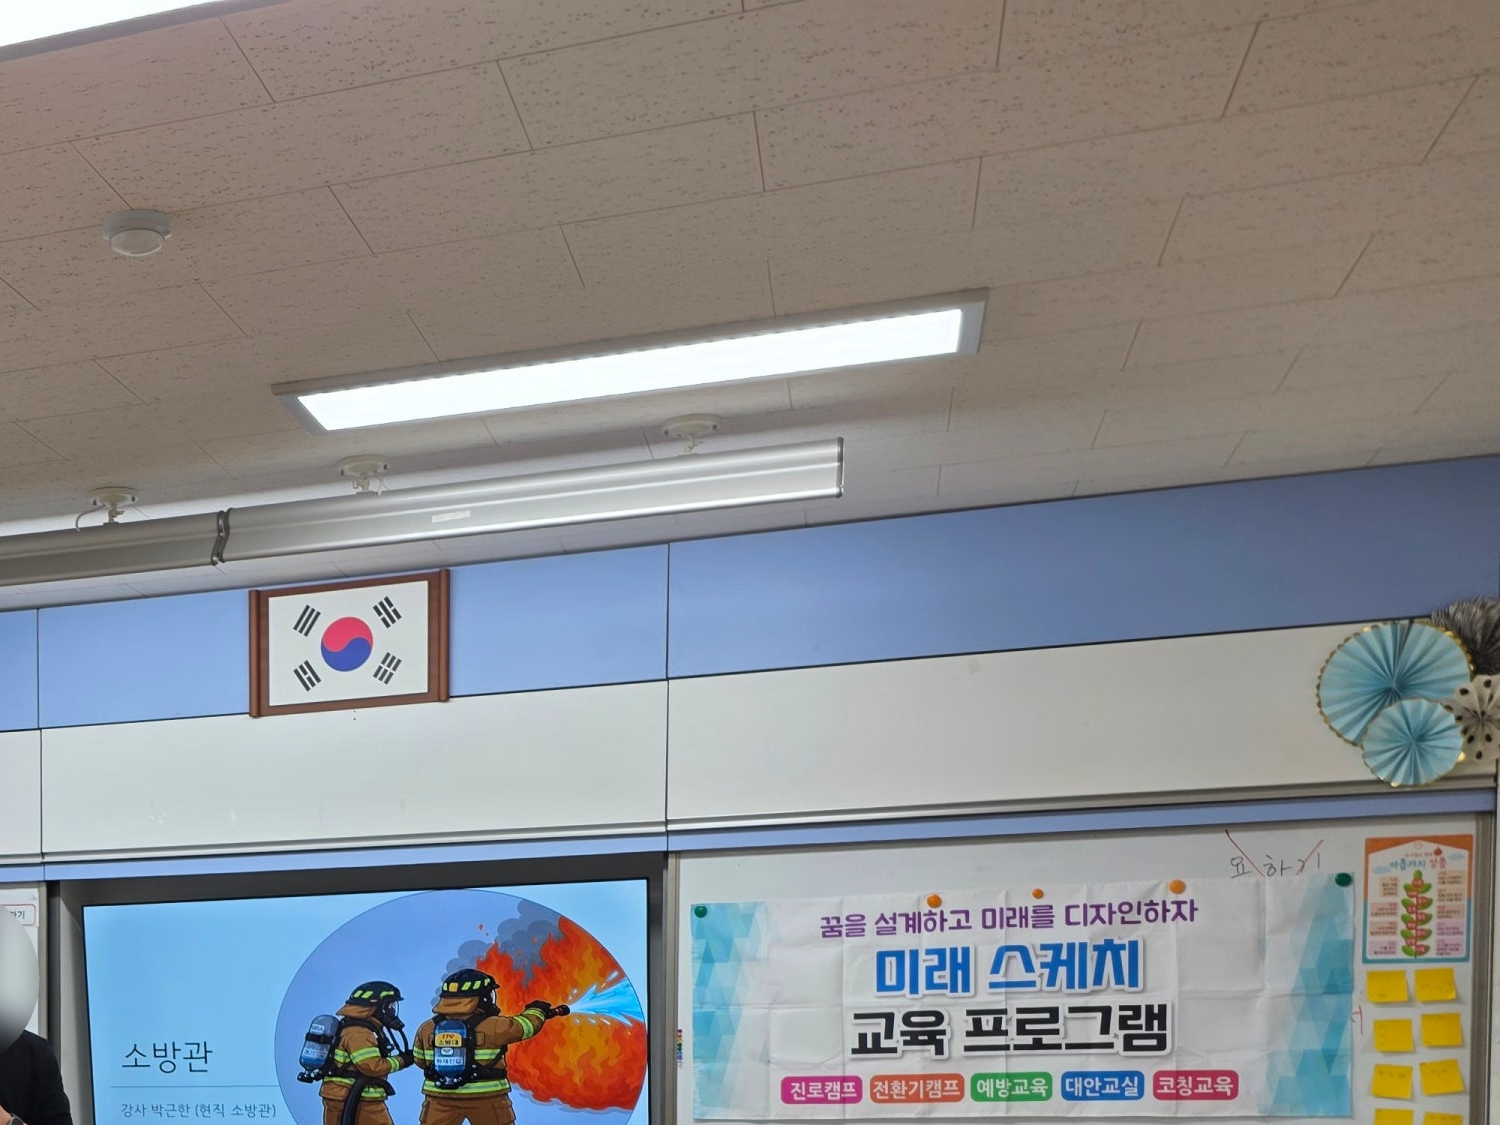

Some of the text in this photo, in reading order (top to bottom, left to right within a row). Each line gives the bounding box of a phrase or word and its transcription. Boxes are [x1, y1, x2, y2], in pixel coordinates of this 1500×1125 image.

[820, 899, 1199, 938] 꿈을 설계하고 미래를 디자인하자
[876, 938, 1139, 995] 미래 스케치
[851, 1003, 1168, 1056] 교육 프로그램
[122, 1041, 213, 1073] 소방관
[790, 1075, 1234, 1100] 진로캠프 전환기캠프 예방교육 대안교실 코칭교육
[121, 1104, 276, 1118] 강사 박근한 (현직 소방관)
